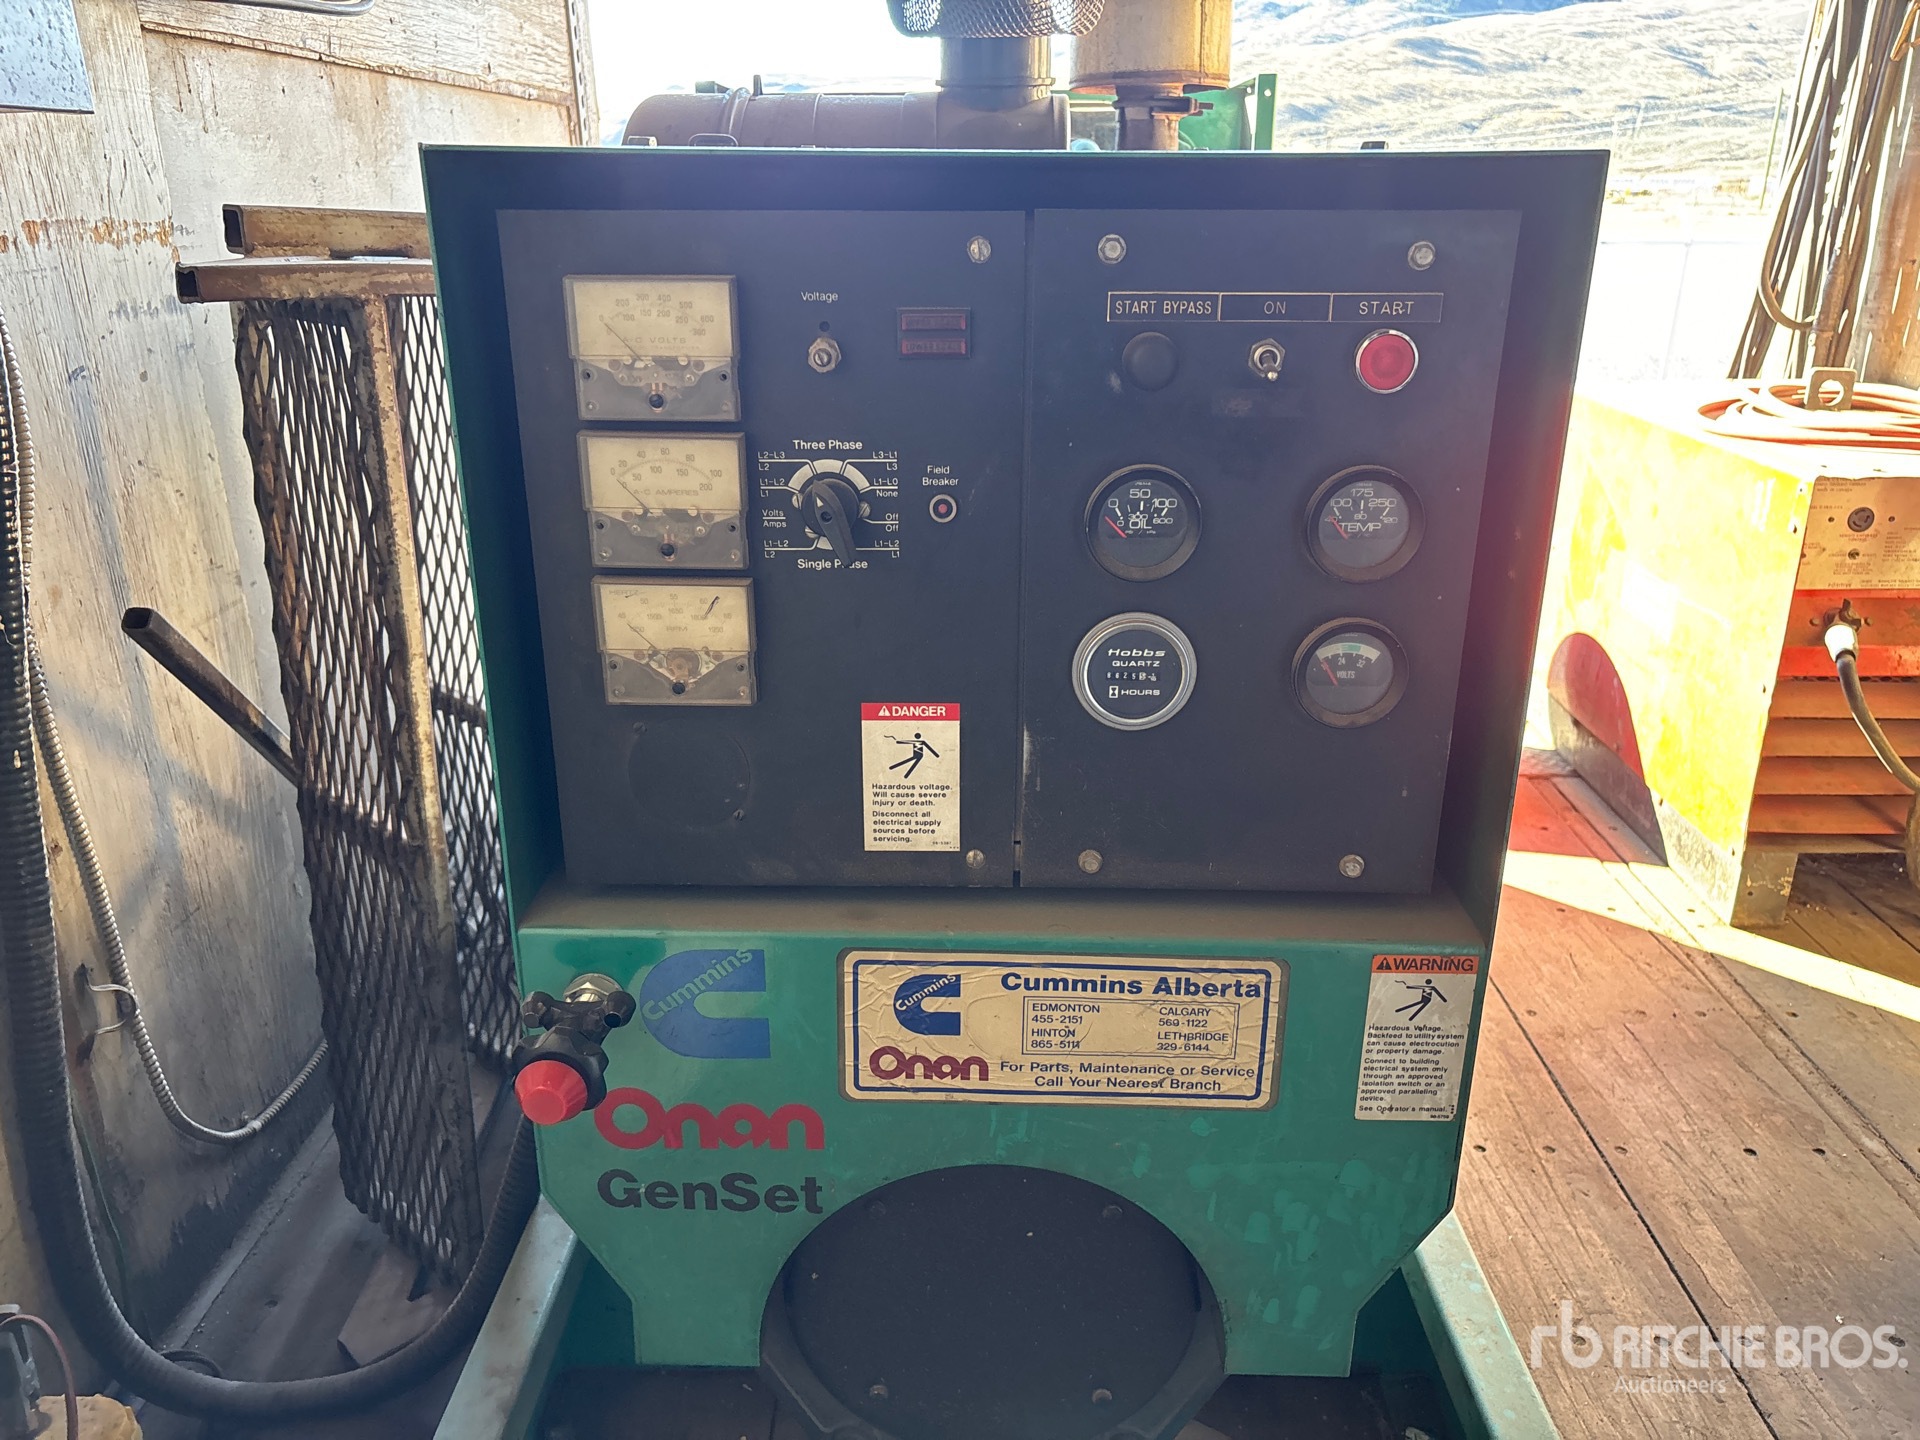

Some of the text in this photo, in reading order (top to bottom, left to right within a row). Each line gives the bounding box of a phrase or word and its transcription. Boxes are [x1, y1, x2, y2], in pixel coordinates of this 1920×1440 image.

[801, 291, 839, 303] Voltage
[679, 301, 693, 309] 500
[1115, 301, 1212, 315] START BYPASS
[1263, 301, 1286, 315] ON
[1359, 301, 1415, 316] START
[793, 440, 863, 450] Three Phase
[637, 450, 647, 458] 40
[660, 448, 670, 456] 60
[685, 454, 695, 463] 80
[618, 460, 628, 468] 20
[758, 463, 770, 471] L2
[886, 463, 898, 471] L3
[650, 466, 662, 474] 100
[676, 469, 689, 477] 150
[710, 469, 722, 477] 100
[927, 465, 950, 474] Field
[632, 473, 642, 481] 50
[759, 478, 785, 486] L1-L2
[922, 477, 959, 487] Breaker
[699, 483, 713, 491] 200
[655, 488, 699, 497] AMPERES
[876, 490, 898, 498] None
[1129, 489, 1150, 498] 50
[1351, 488, 1374, 497] 175
[1108, 498, 1119, 508] 0
[1152, 498, 1177, 508] 100
[1330, 498, 1352, 507] 100
[1368, 498, 1396, 507] 250
[762, 509, 784, 517] Volts
[886, 513, 899, 521] Off
[1129, 519, 1152, 529] OIL
[1339, 522, 1381, 532] TEMP
[798, 559, 831, 570] Single
[892, 706, 946, 716] DANGER
[1394, 958, 1473, 971] WARNING
[642, 950, 752, 1020] Cummins
[1001, 972, 1261, 998] Cummins Alberta
[895, 975, 956, 1011] Cummins
[1032, 1003, 1100, 1013] EDMONTON
[1160, 1007, 1211, 1016] CALGARY
[1031, 1029, 1075, 1037] HINTON
[1157, 1032, 1229, 1041] LETHBRIDGE
[1157, 1043, 1209, 1051] 329-6144
[869, 1046, 989, 1081] Onan
[1000, 1061, 1255, 1077] For Parts, Maintenance or Service
[1034, 1076, 1221, 1091] Call Your Nearest Branch
[594, 1086, 825, 1149] Onan
[597, 1169, 823, 1213] GenSet
